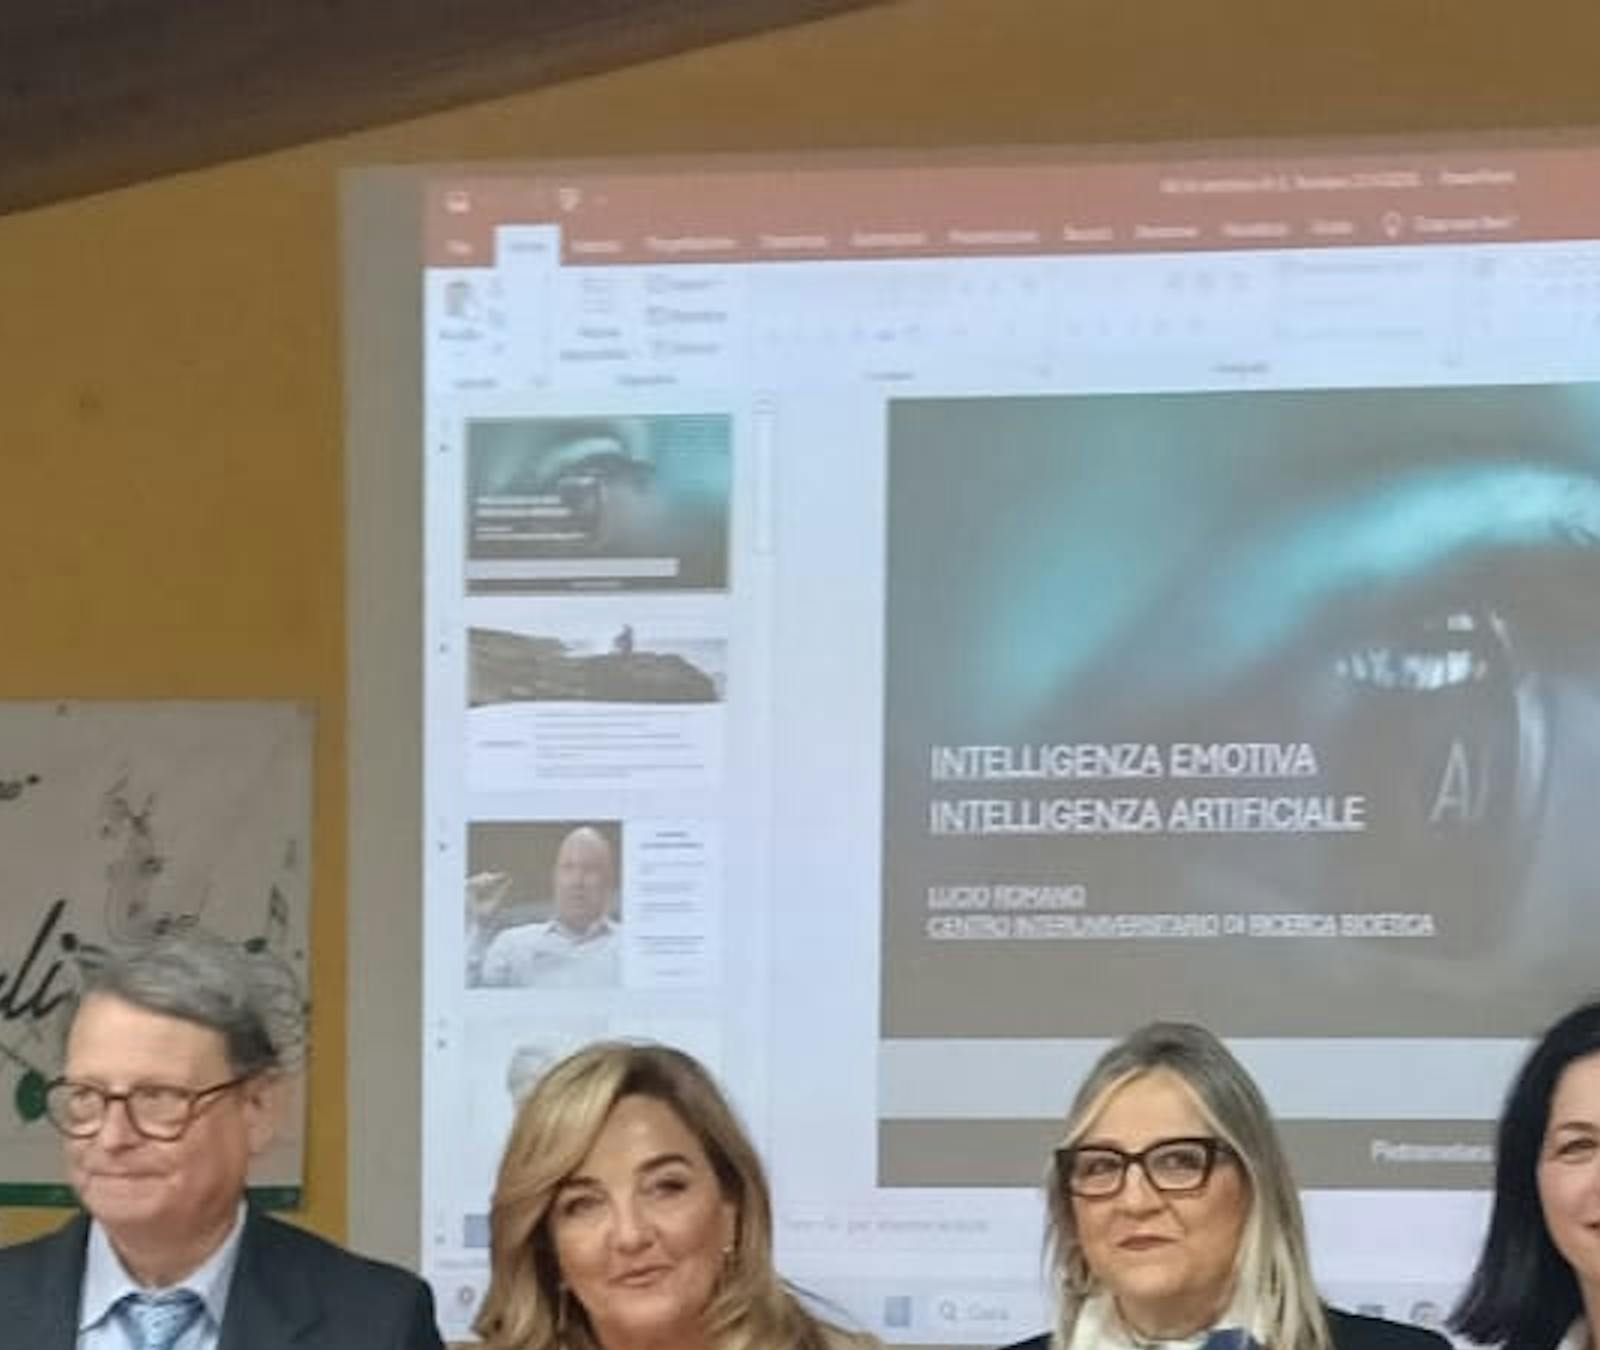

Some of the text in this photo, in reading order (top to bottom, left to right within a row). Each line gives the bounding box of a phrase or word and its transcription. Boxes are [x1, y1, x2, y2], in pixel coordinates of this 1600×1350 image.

[930, 743, 1318, 780] INTELLIGENZA EMOTIVA
[930, 796, 1367, 834] INTELLIGENZA ARTIFICIALE
